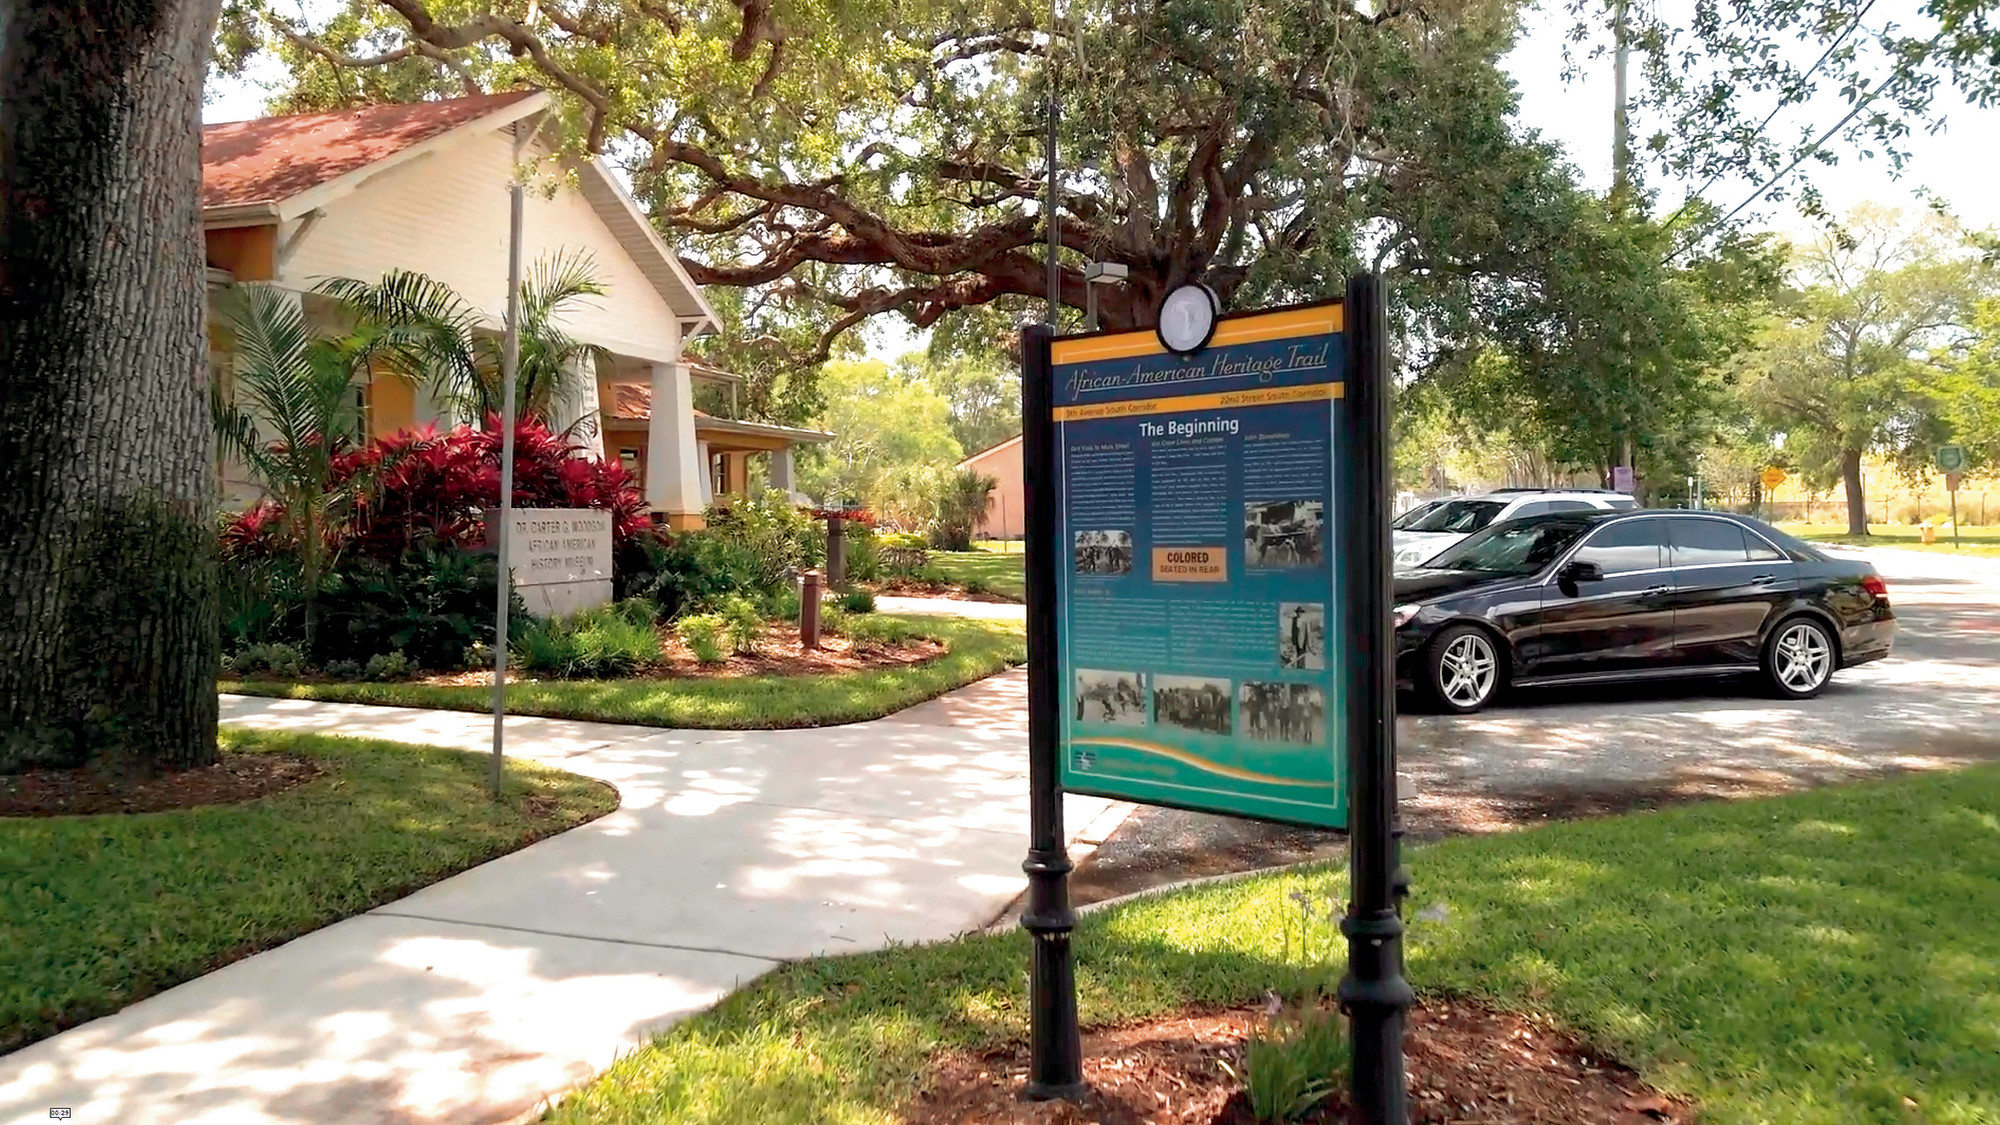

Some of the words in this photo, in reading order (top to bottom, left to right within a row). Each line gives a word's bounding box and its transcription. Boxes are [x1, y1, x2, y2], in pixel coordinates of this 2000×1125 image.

[1065, 364, 1205, 401] African-American
[1211, 353, 1282, 382] Heritage
[1287, 343, 1329, 368] Trail
[1105, 405, 1127, 415] South
[1139, 421, 1164, 437] The
[1168, 417, 1239, 438] Beginning
[531, 520, 560, 534] CARTER
[571, 520, 605, 533] WOODSON
[529, 539, 558, 552] AFRICAN
[562, 538, 596, 551] AMERICAN
[531, 557, 562, 570] HISTORY
[565, 555, 594, 568] MUSEUM
[1167, 551, 1209, 563] COLORED
[1160, 565, 1187, 574] SEATED
[1189, 565, 1197, 573] IN
[1199, 565, 1219, 574] REAR
